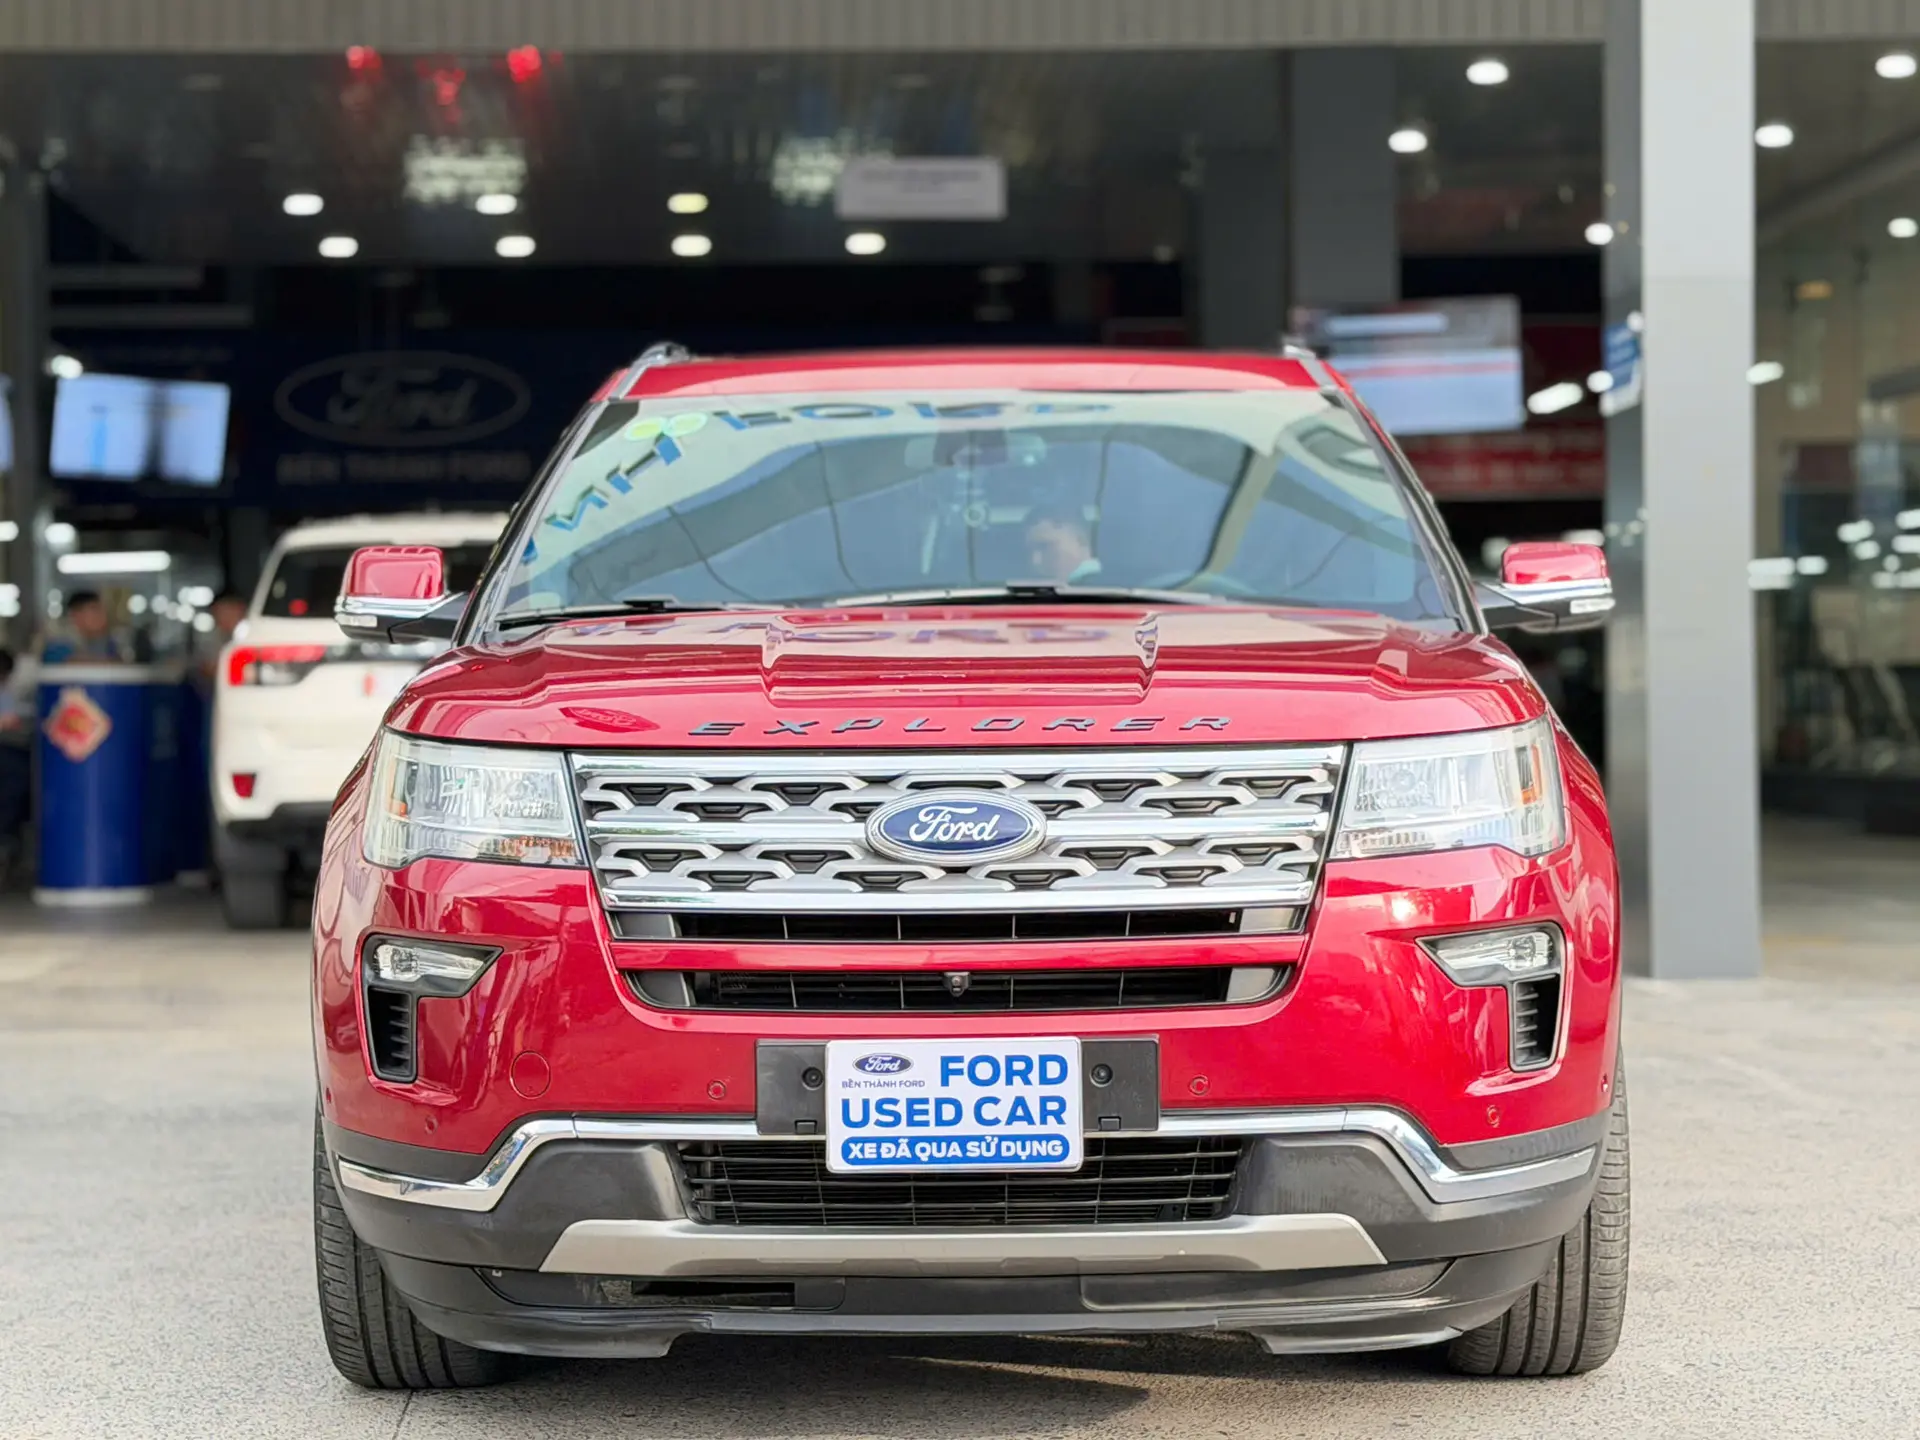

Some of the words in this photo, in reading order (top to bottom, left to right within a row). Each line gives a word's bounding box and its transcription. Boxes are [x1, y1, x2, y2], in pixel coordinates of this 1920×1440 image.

[688, 717, 1232, 736] EXPLORER
[908, 805, 1001, 842] Ford
[864, 1056, 901, 1072] Ford
[940, 1054, 1069, 1087] FORD
[899, 1080, 926, 1088] FORD
[841, 1097, 963, 1129] USED
[974, 1095, 1067, 1127] CAR
[848, 1142, 878, 1159] XE
[880, 1138, 912, 1158] ĐÃ
[916, 1141, 963, 1162] QUA
[966, 1135, 999, 1158] SỬ
[1001, 1140, 1064, 1161] DỤNG
